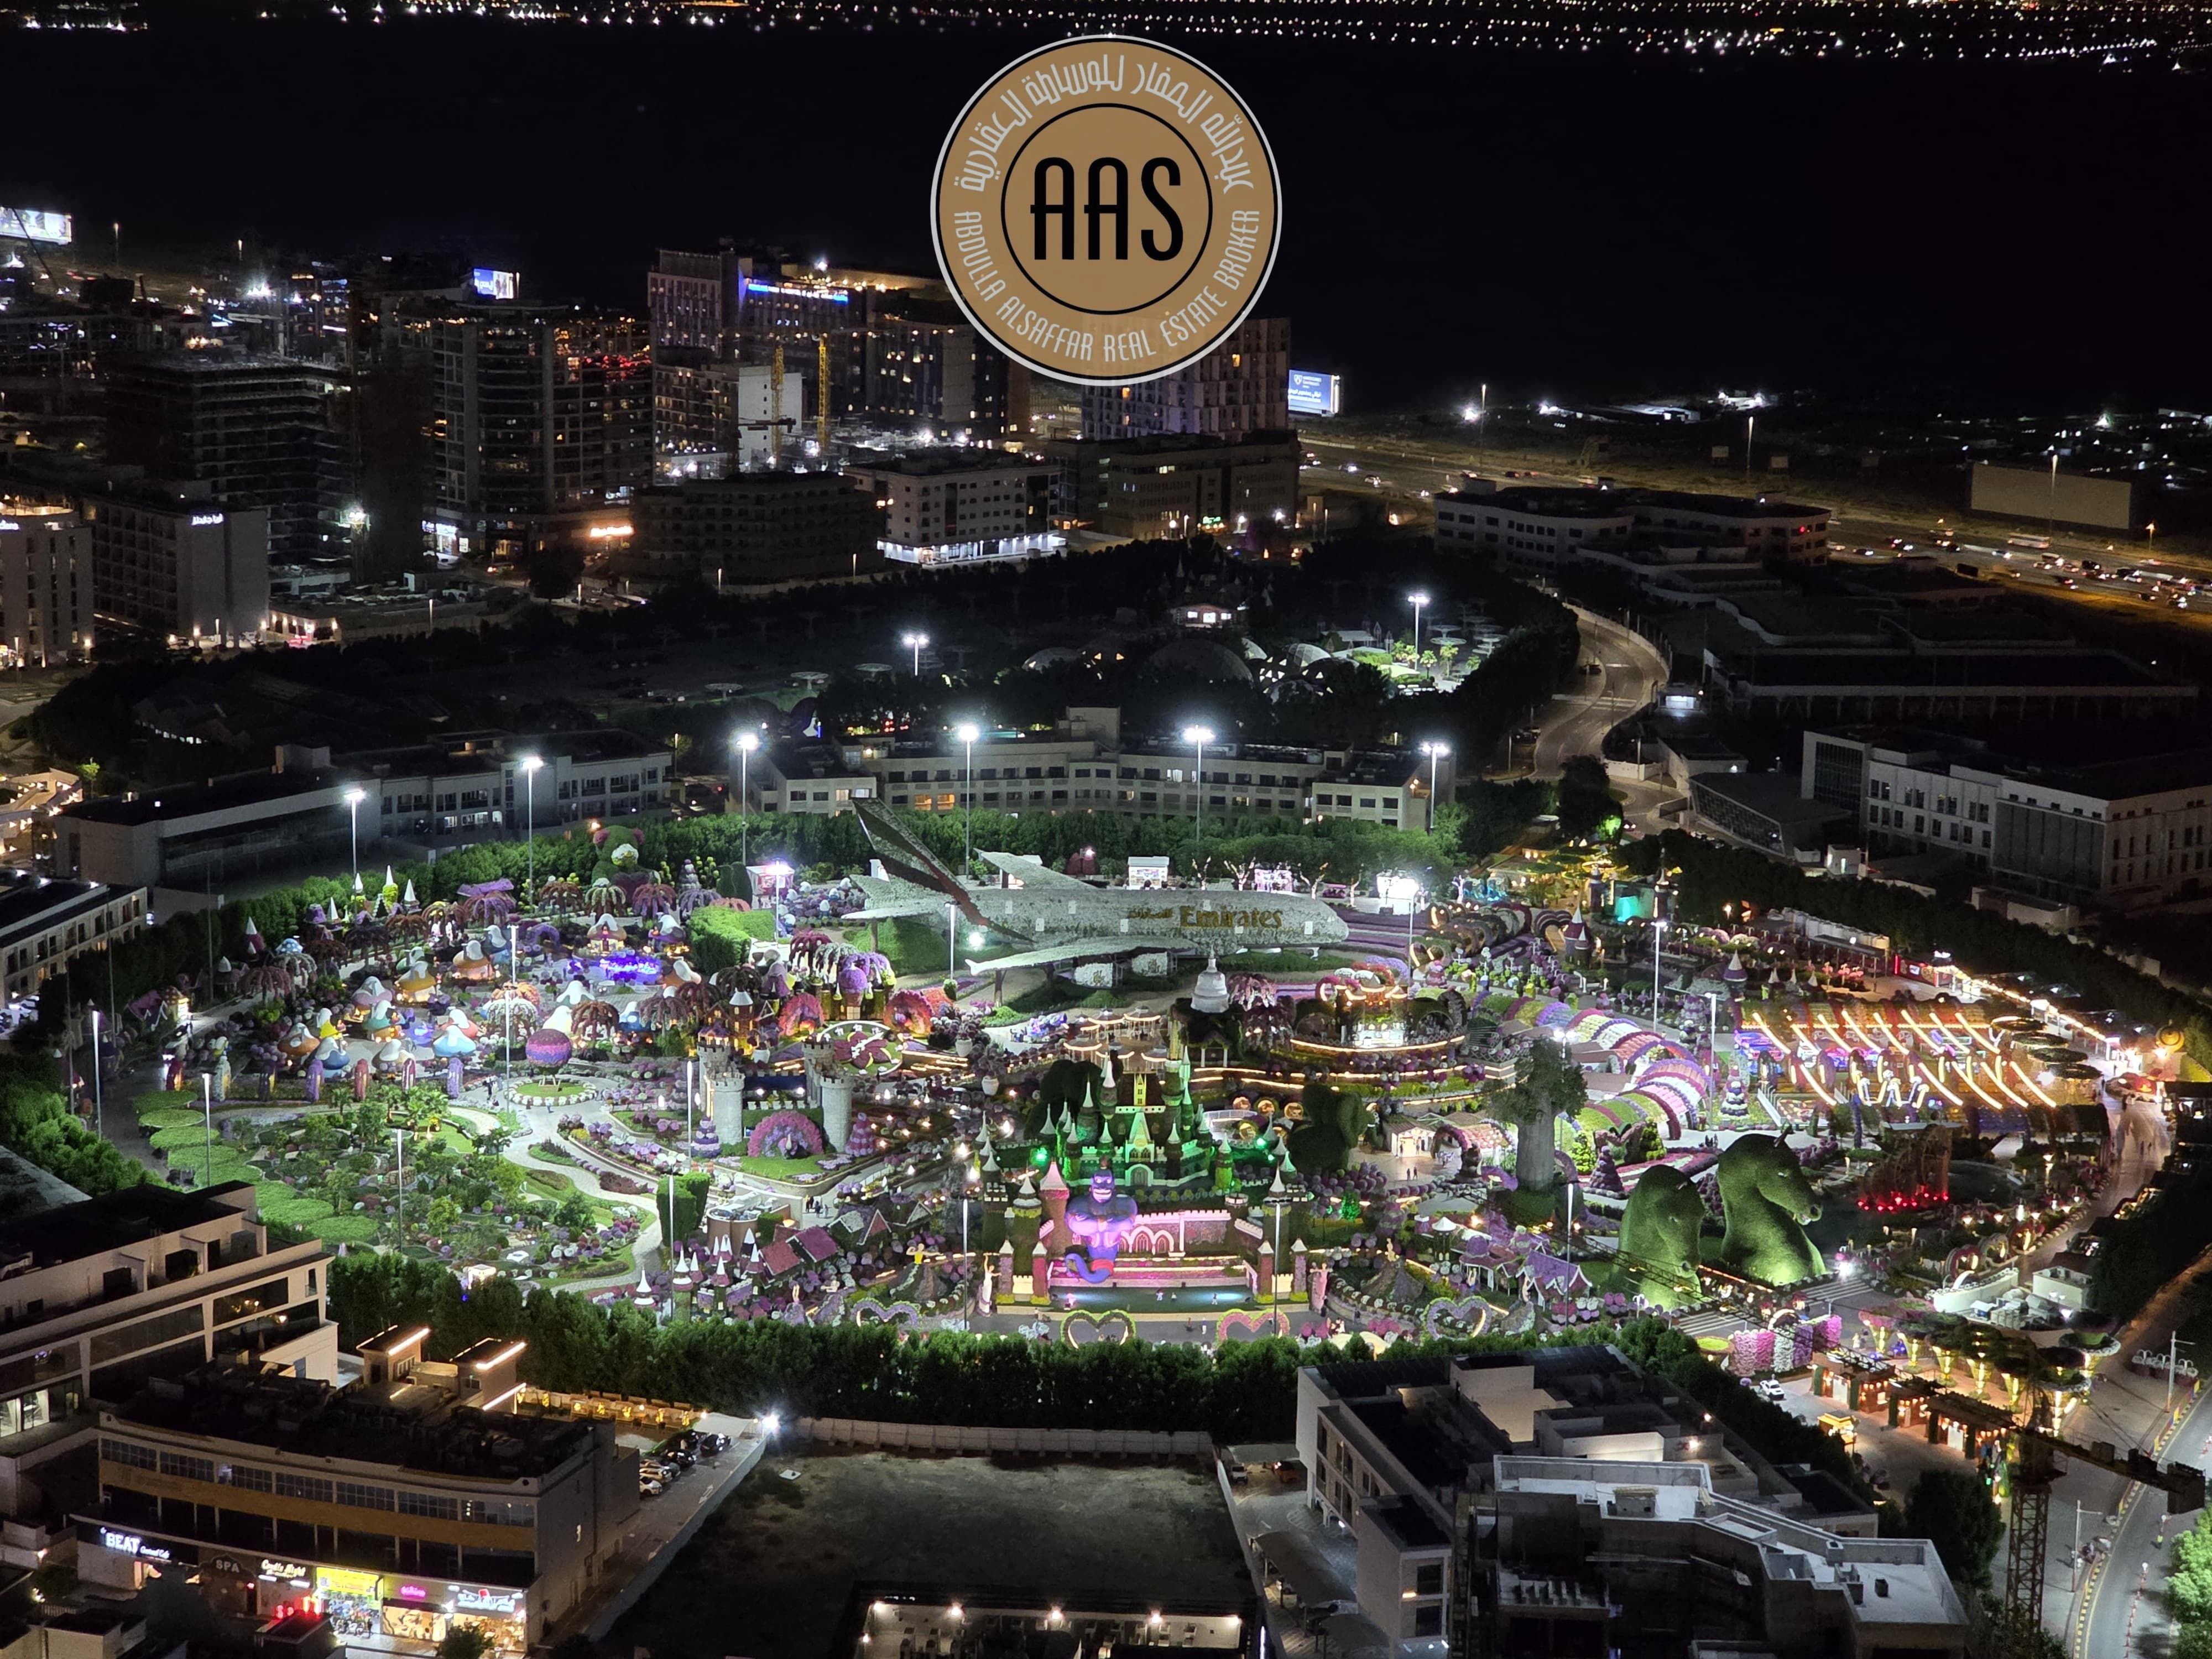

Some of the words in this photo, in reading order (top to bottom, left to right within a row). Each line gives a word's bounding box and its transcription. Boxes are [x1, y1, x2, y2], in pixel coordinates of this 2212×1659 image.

[1180, 905, 1284, 928] Emirates
[106, 1532, 140, 1553] BEAT
[216, 1559, 239, 1573] SPA
